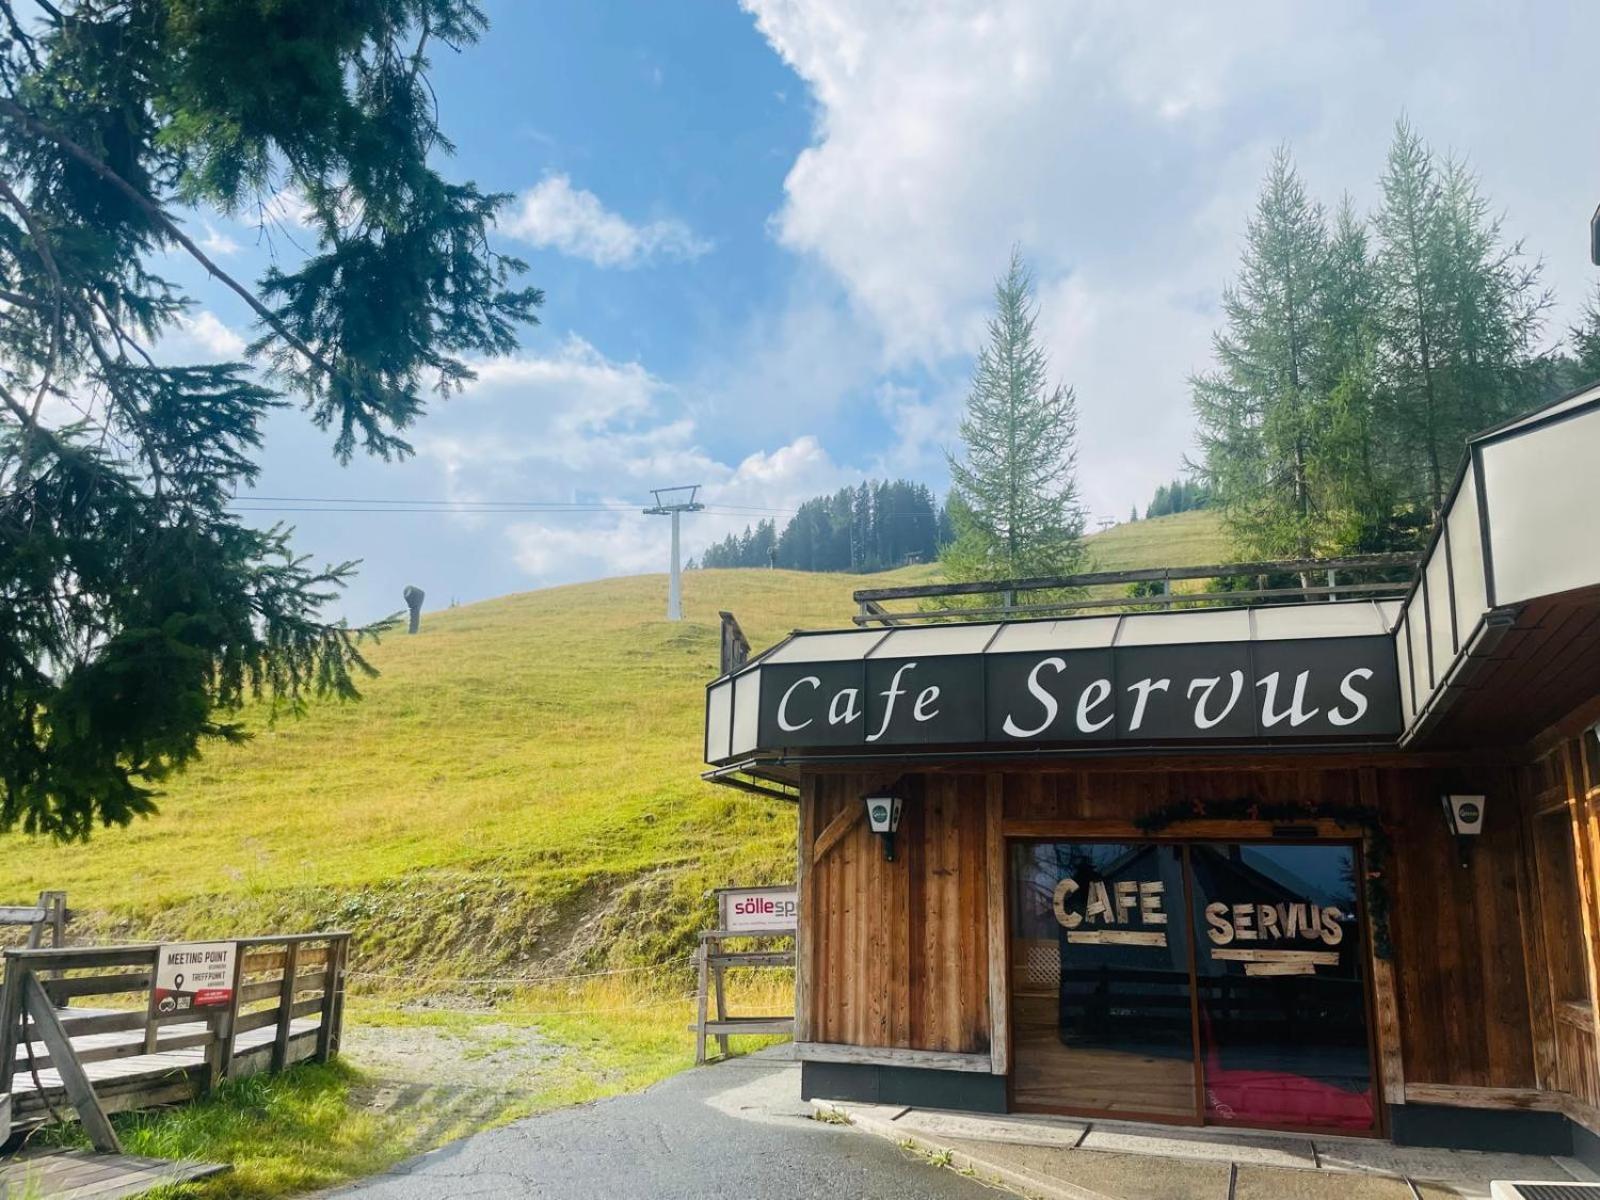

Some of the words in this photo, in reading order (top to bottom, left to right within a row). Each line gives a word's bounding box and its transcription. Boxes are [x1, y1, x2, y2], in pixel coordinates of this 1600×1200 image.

[776, 662, 941, 742] Cafe
[1002, 657, 1374, 737] Servus
[735, 898, 795, 917] söllesp
[1052, 878, 1168, 929] CAFE
[1205, 901, 1344, 946] SERVUS
[167, 952, 203, 966] MEETING
[205, 951, 227, 963] POINT
